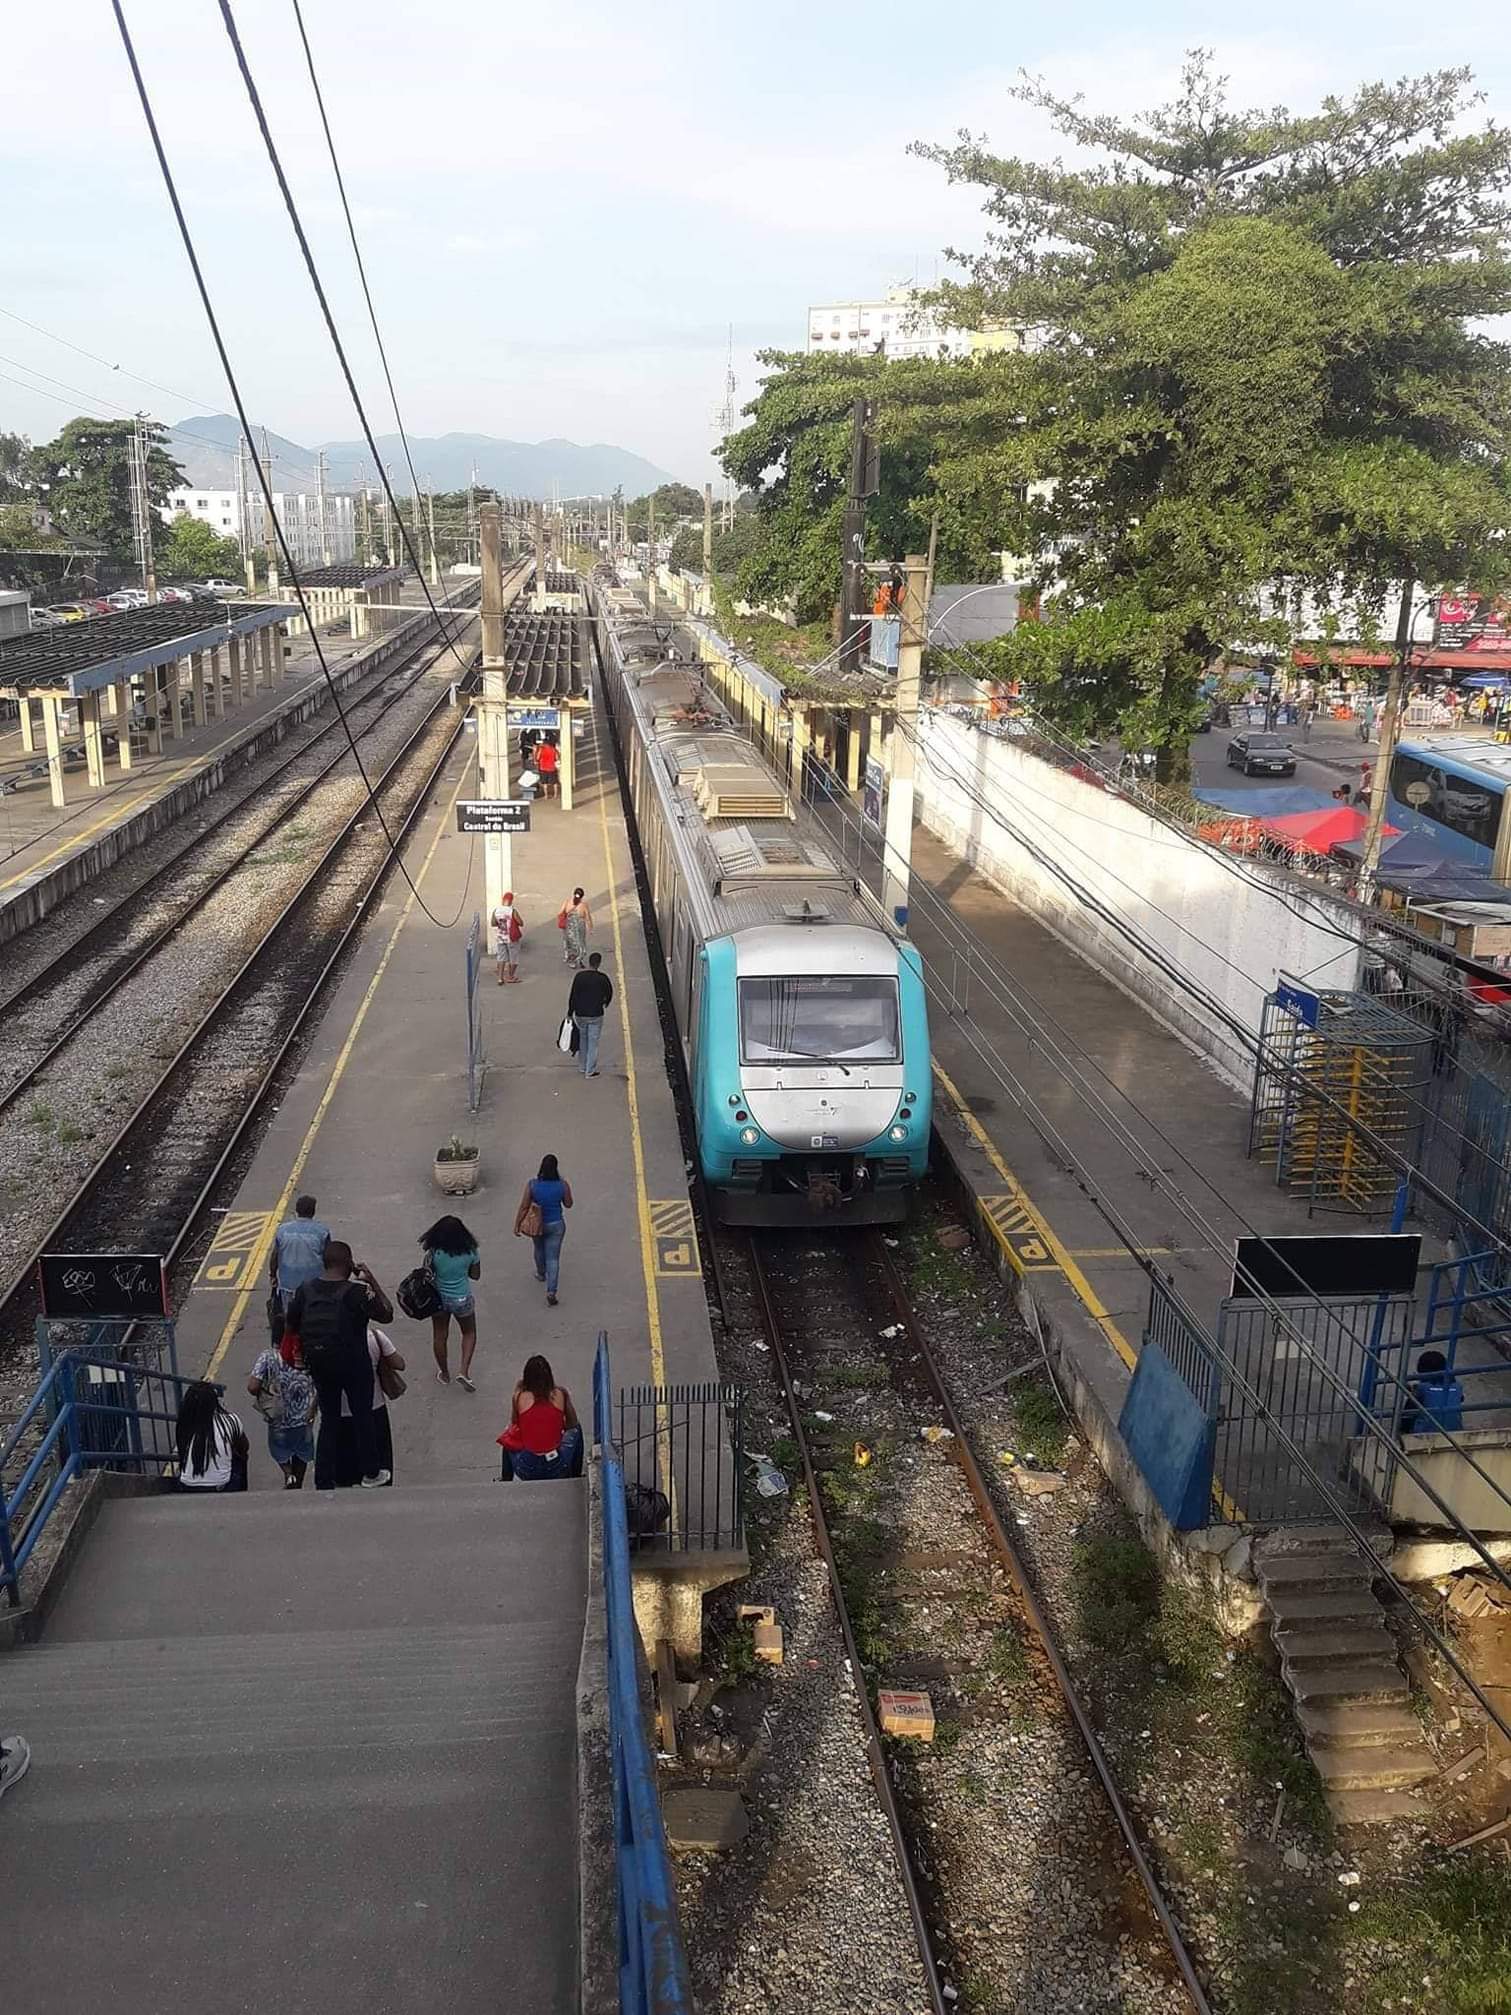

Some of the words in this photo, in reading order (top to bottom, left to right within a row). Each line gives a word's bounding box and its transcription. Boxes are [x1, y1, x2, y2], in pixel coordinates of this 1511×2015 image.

[466, 806, 514, 815] Plataforma
[515, 806, 522, 815] 2
[464, 822, 491, 831] Central
[503, 822, 525, 831] Brasil
